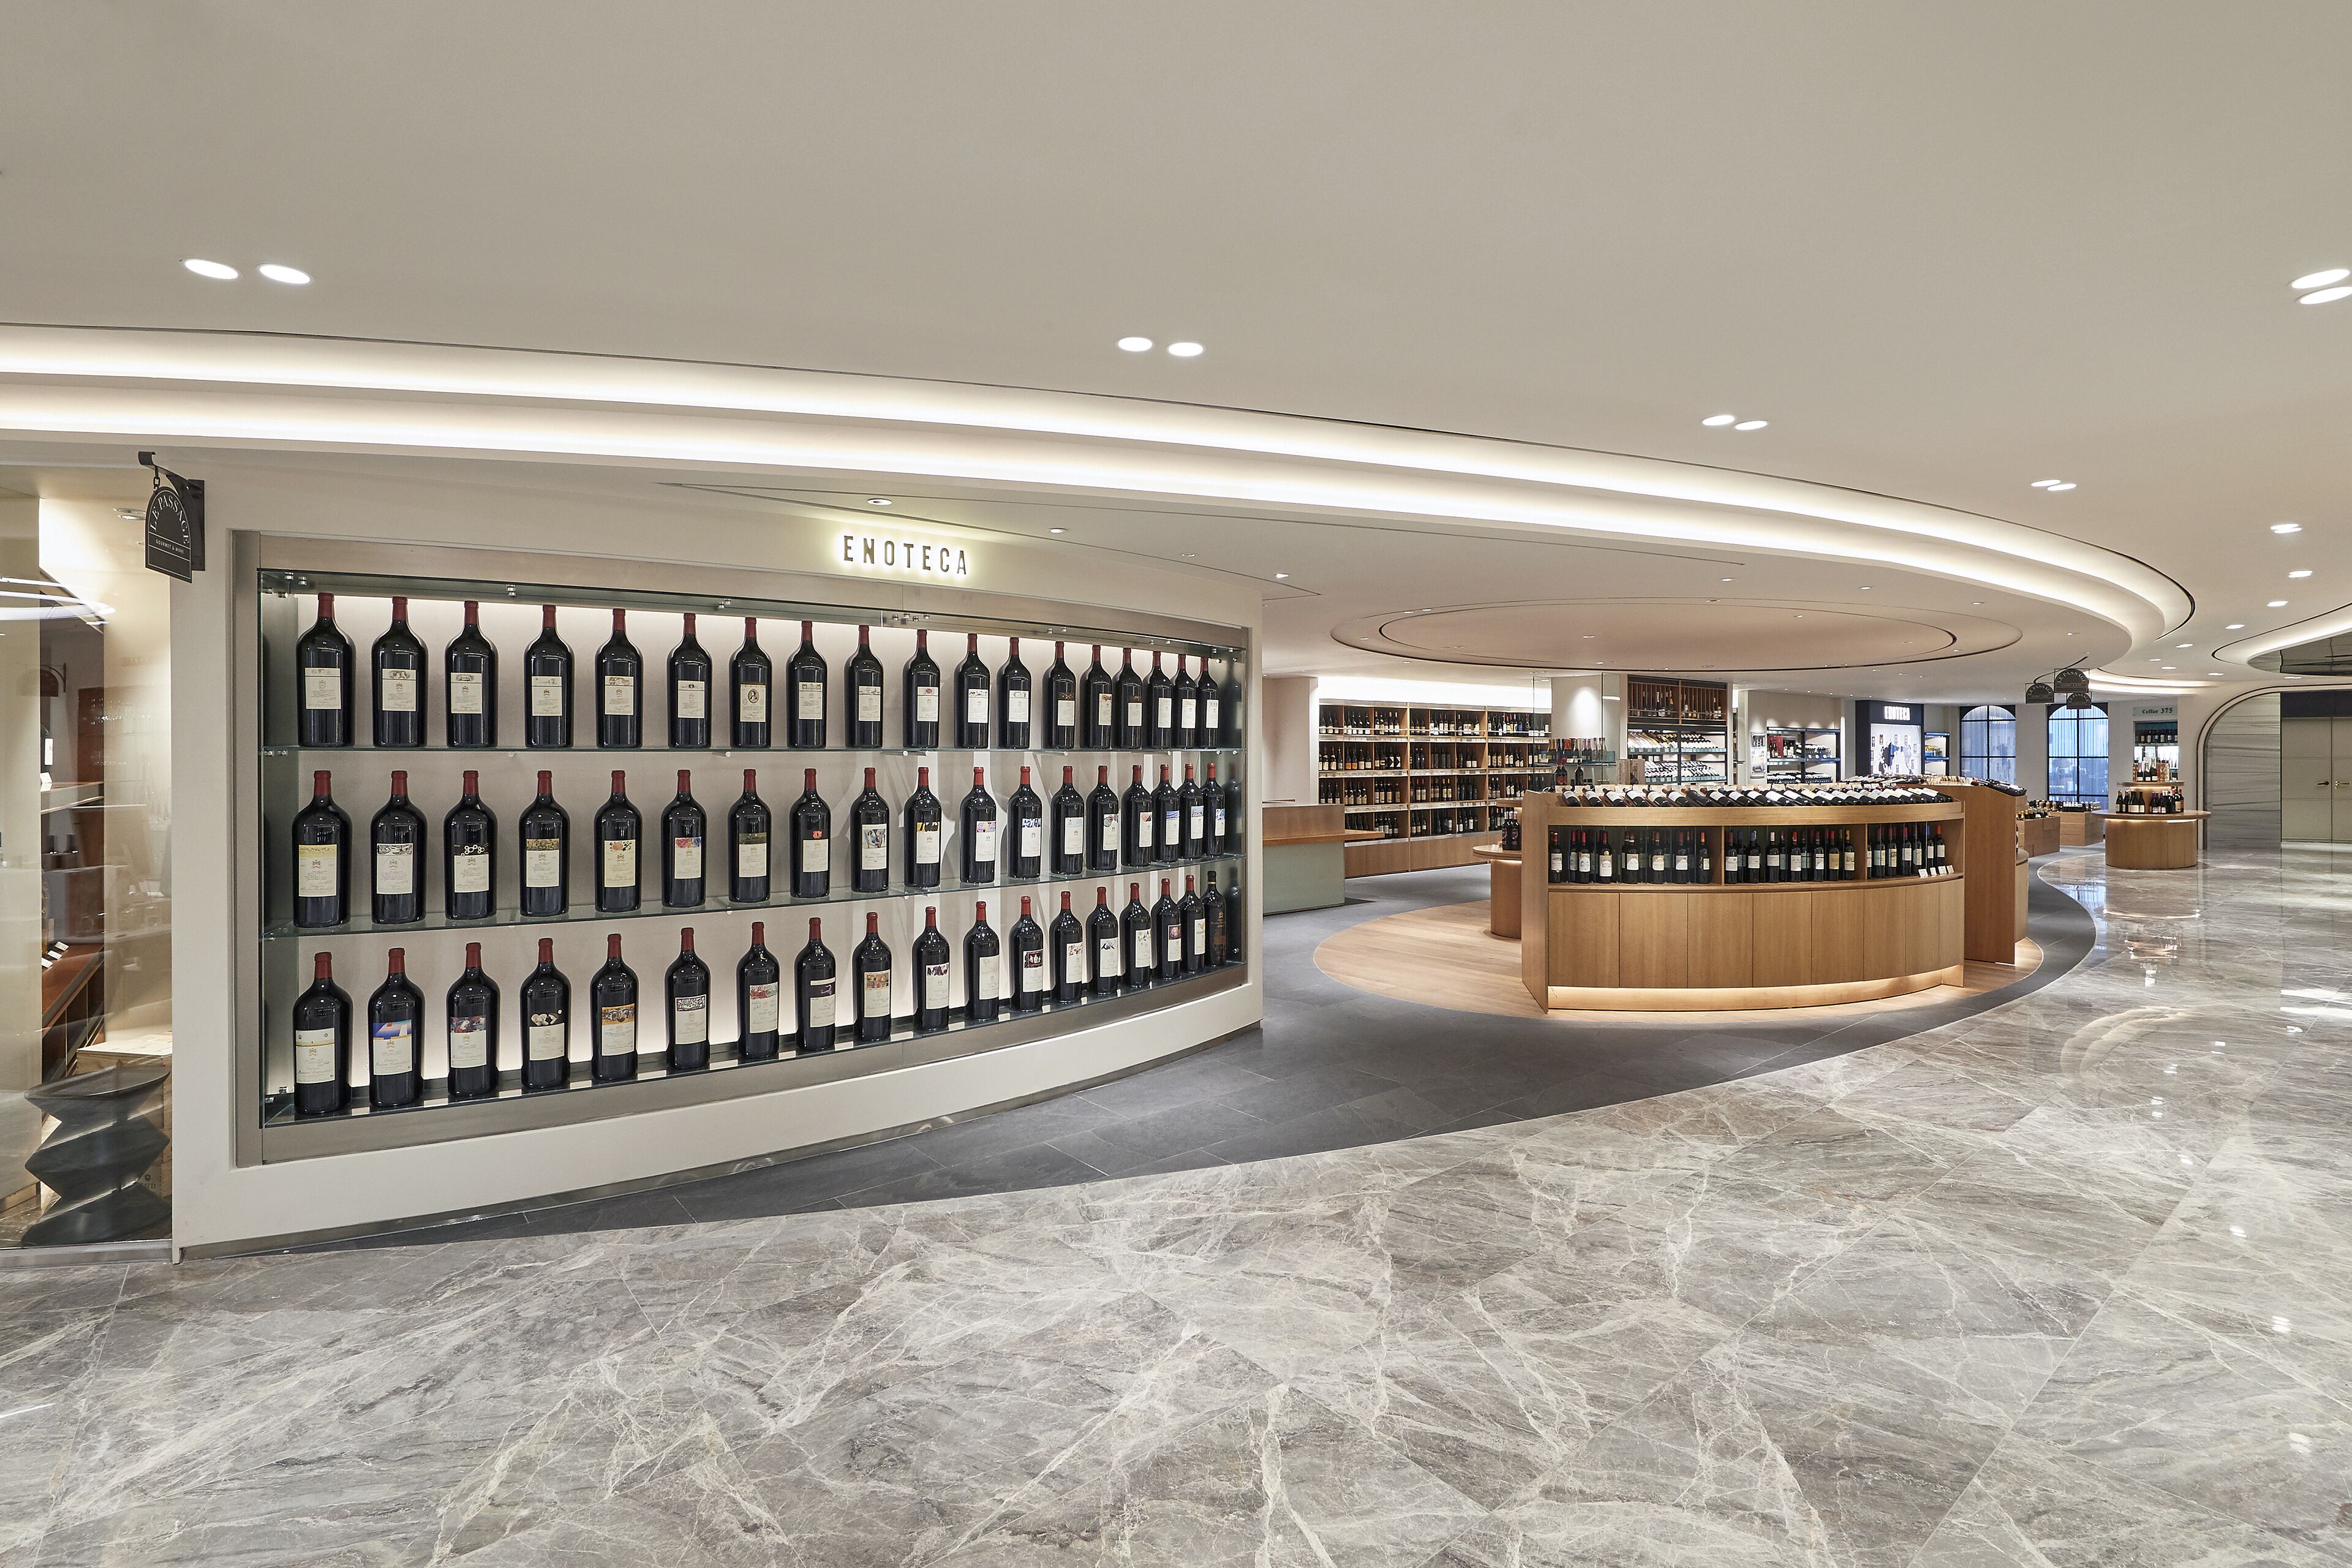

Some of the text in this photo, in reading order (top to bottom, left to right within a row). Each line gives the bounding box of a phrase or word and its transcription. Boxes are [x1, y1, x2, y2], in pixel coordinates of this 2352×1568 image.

[150, 494, 189, 544] LE PASSAGE
[156, 539, 172, 549] GOURMET
[844, 535, 967, 575] ENOTECA
